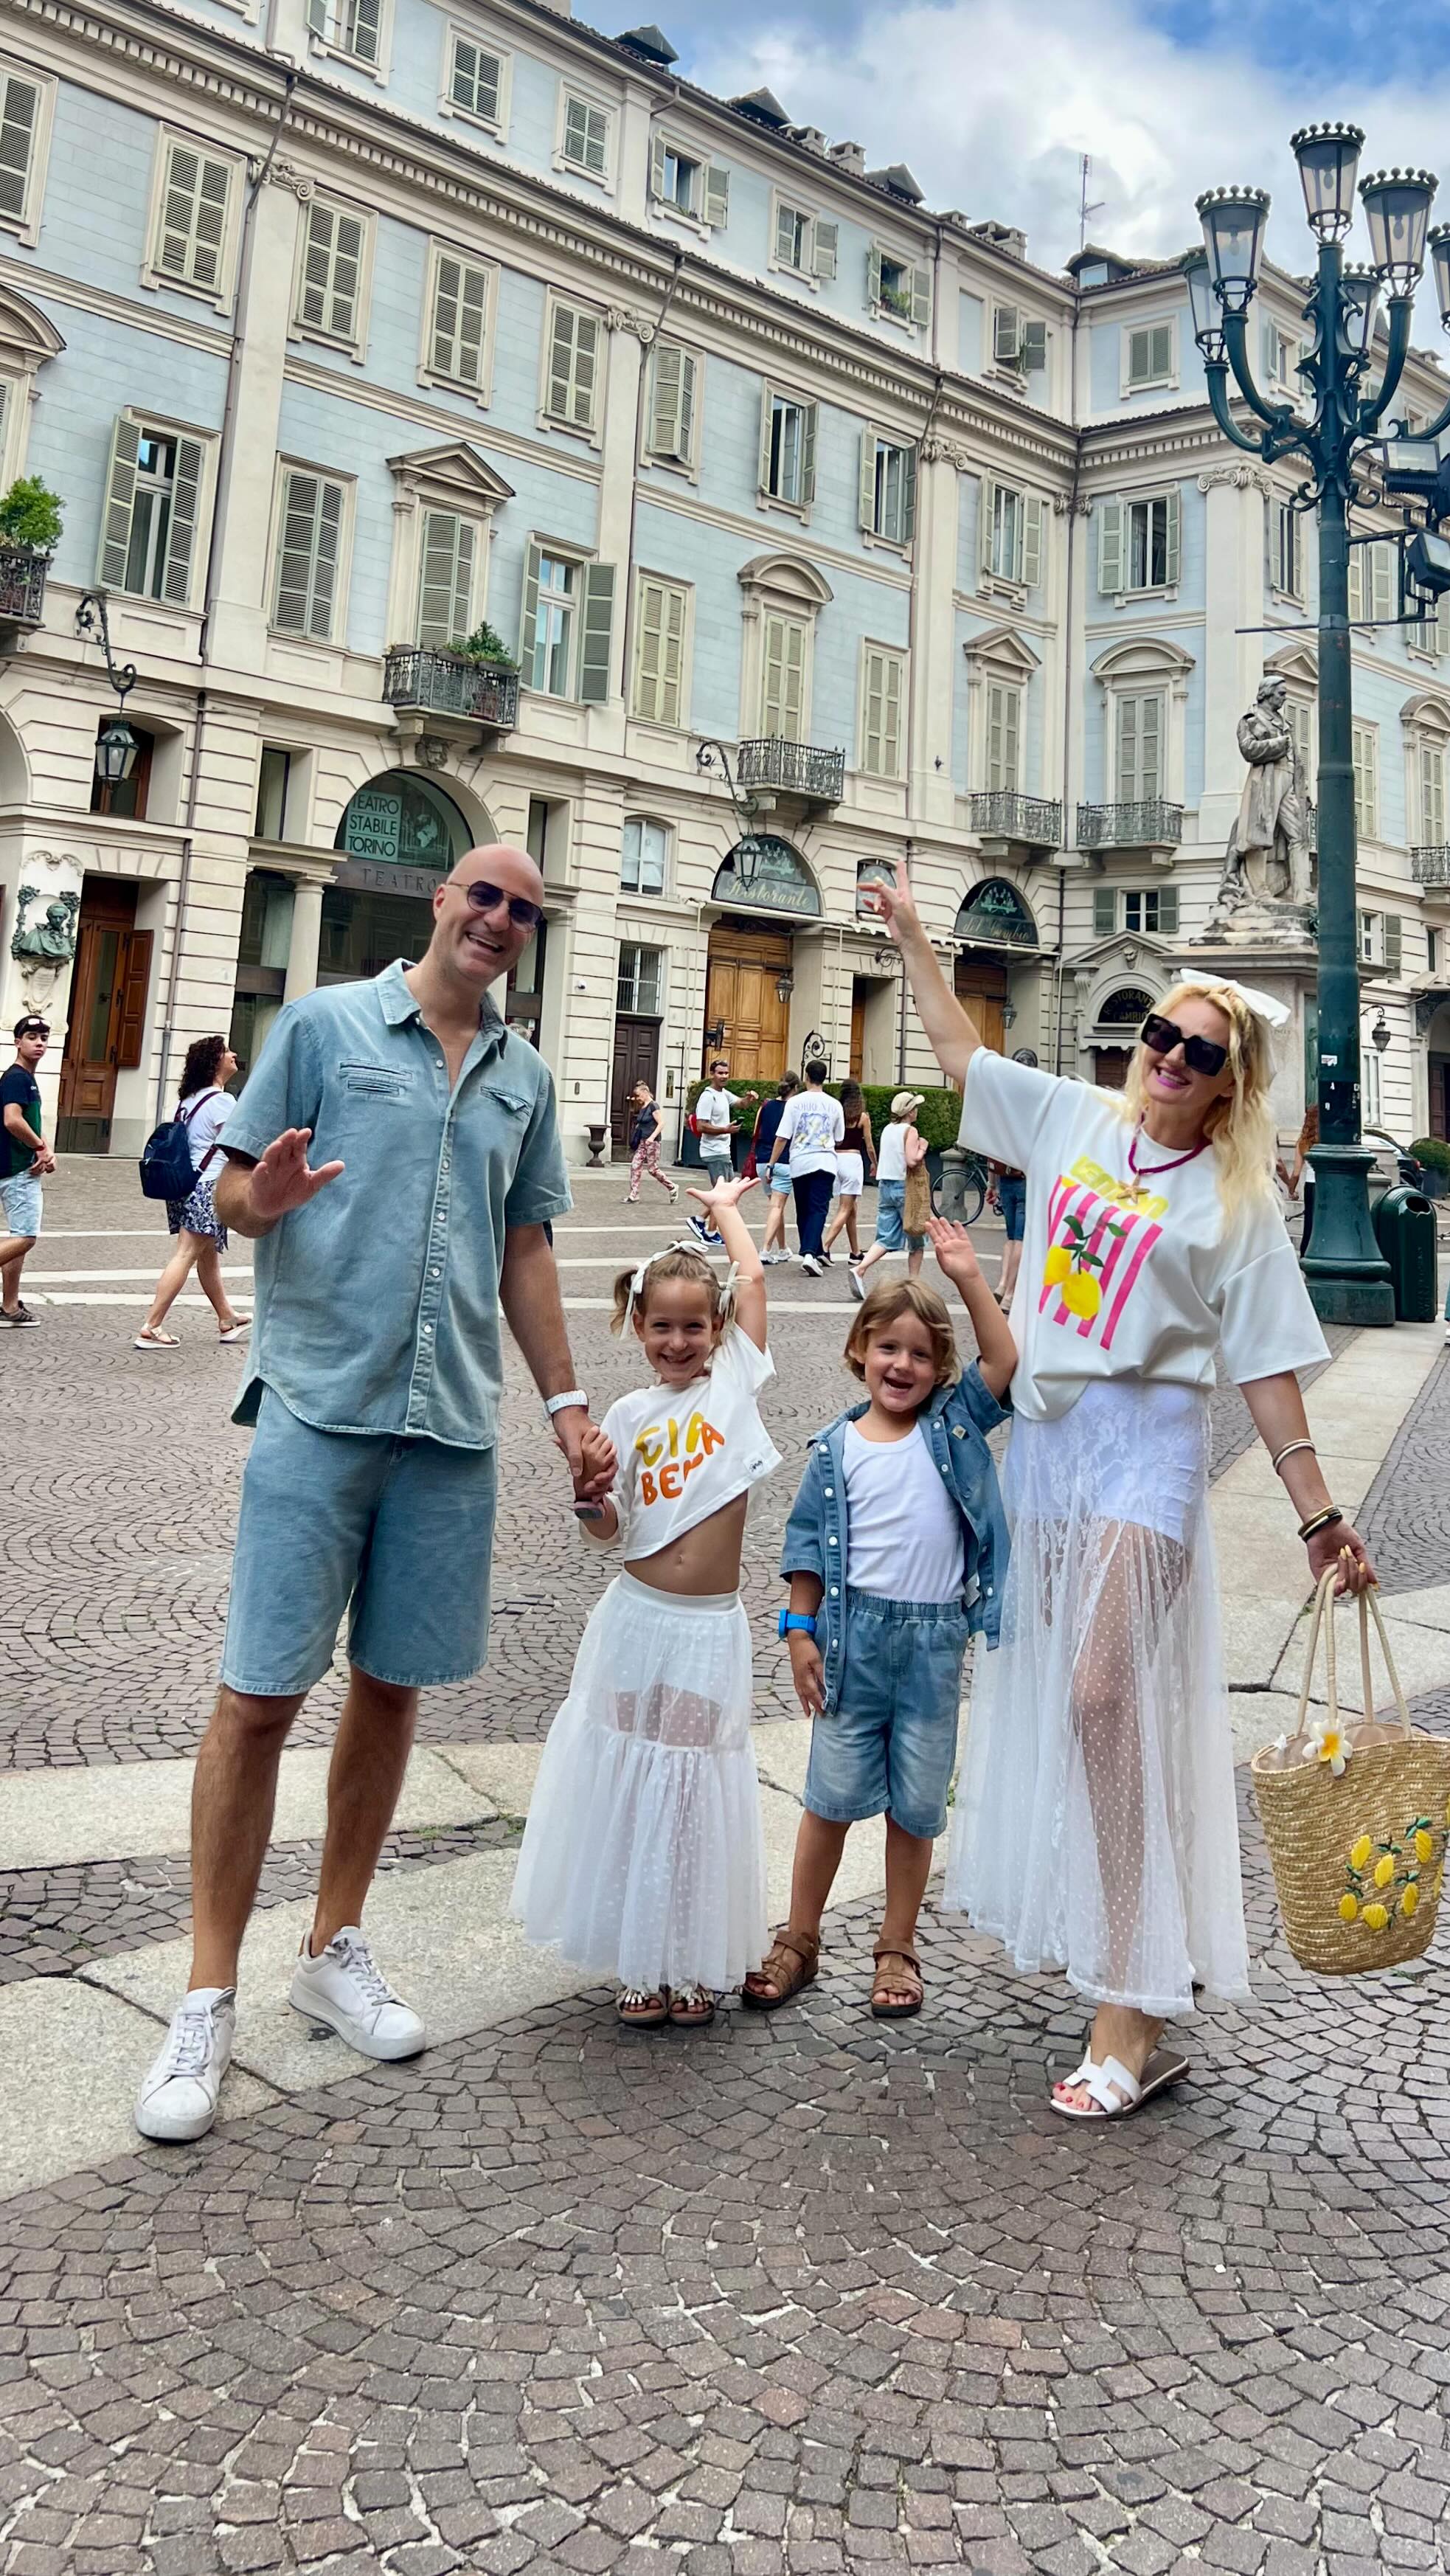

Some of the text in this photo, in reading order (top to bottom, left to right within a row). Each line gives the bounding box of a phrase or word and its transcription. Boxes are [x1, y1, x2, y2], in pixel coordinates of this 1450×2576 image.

[353, 794, 399, 814] TEATRO
[349, 814, 397, 836] STABILE
[348, 835, 395, 856] TORINO
[361, 868, 437, 893] TEATRO
[726, 880, 812, 910] Ristorante
[962, 917, 982, 933] del
[1103, 990, 1156, 1015] RISTORANT
